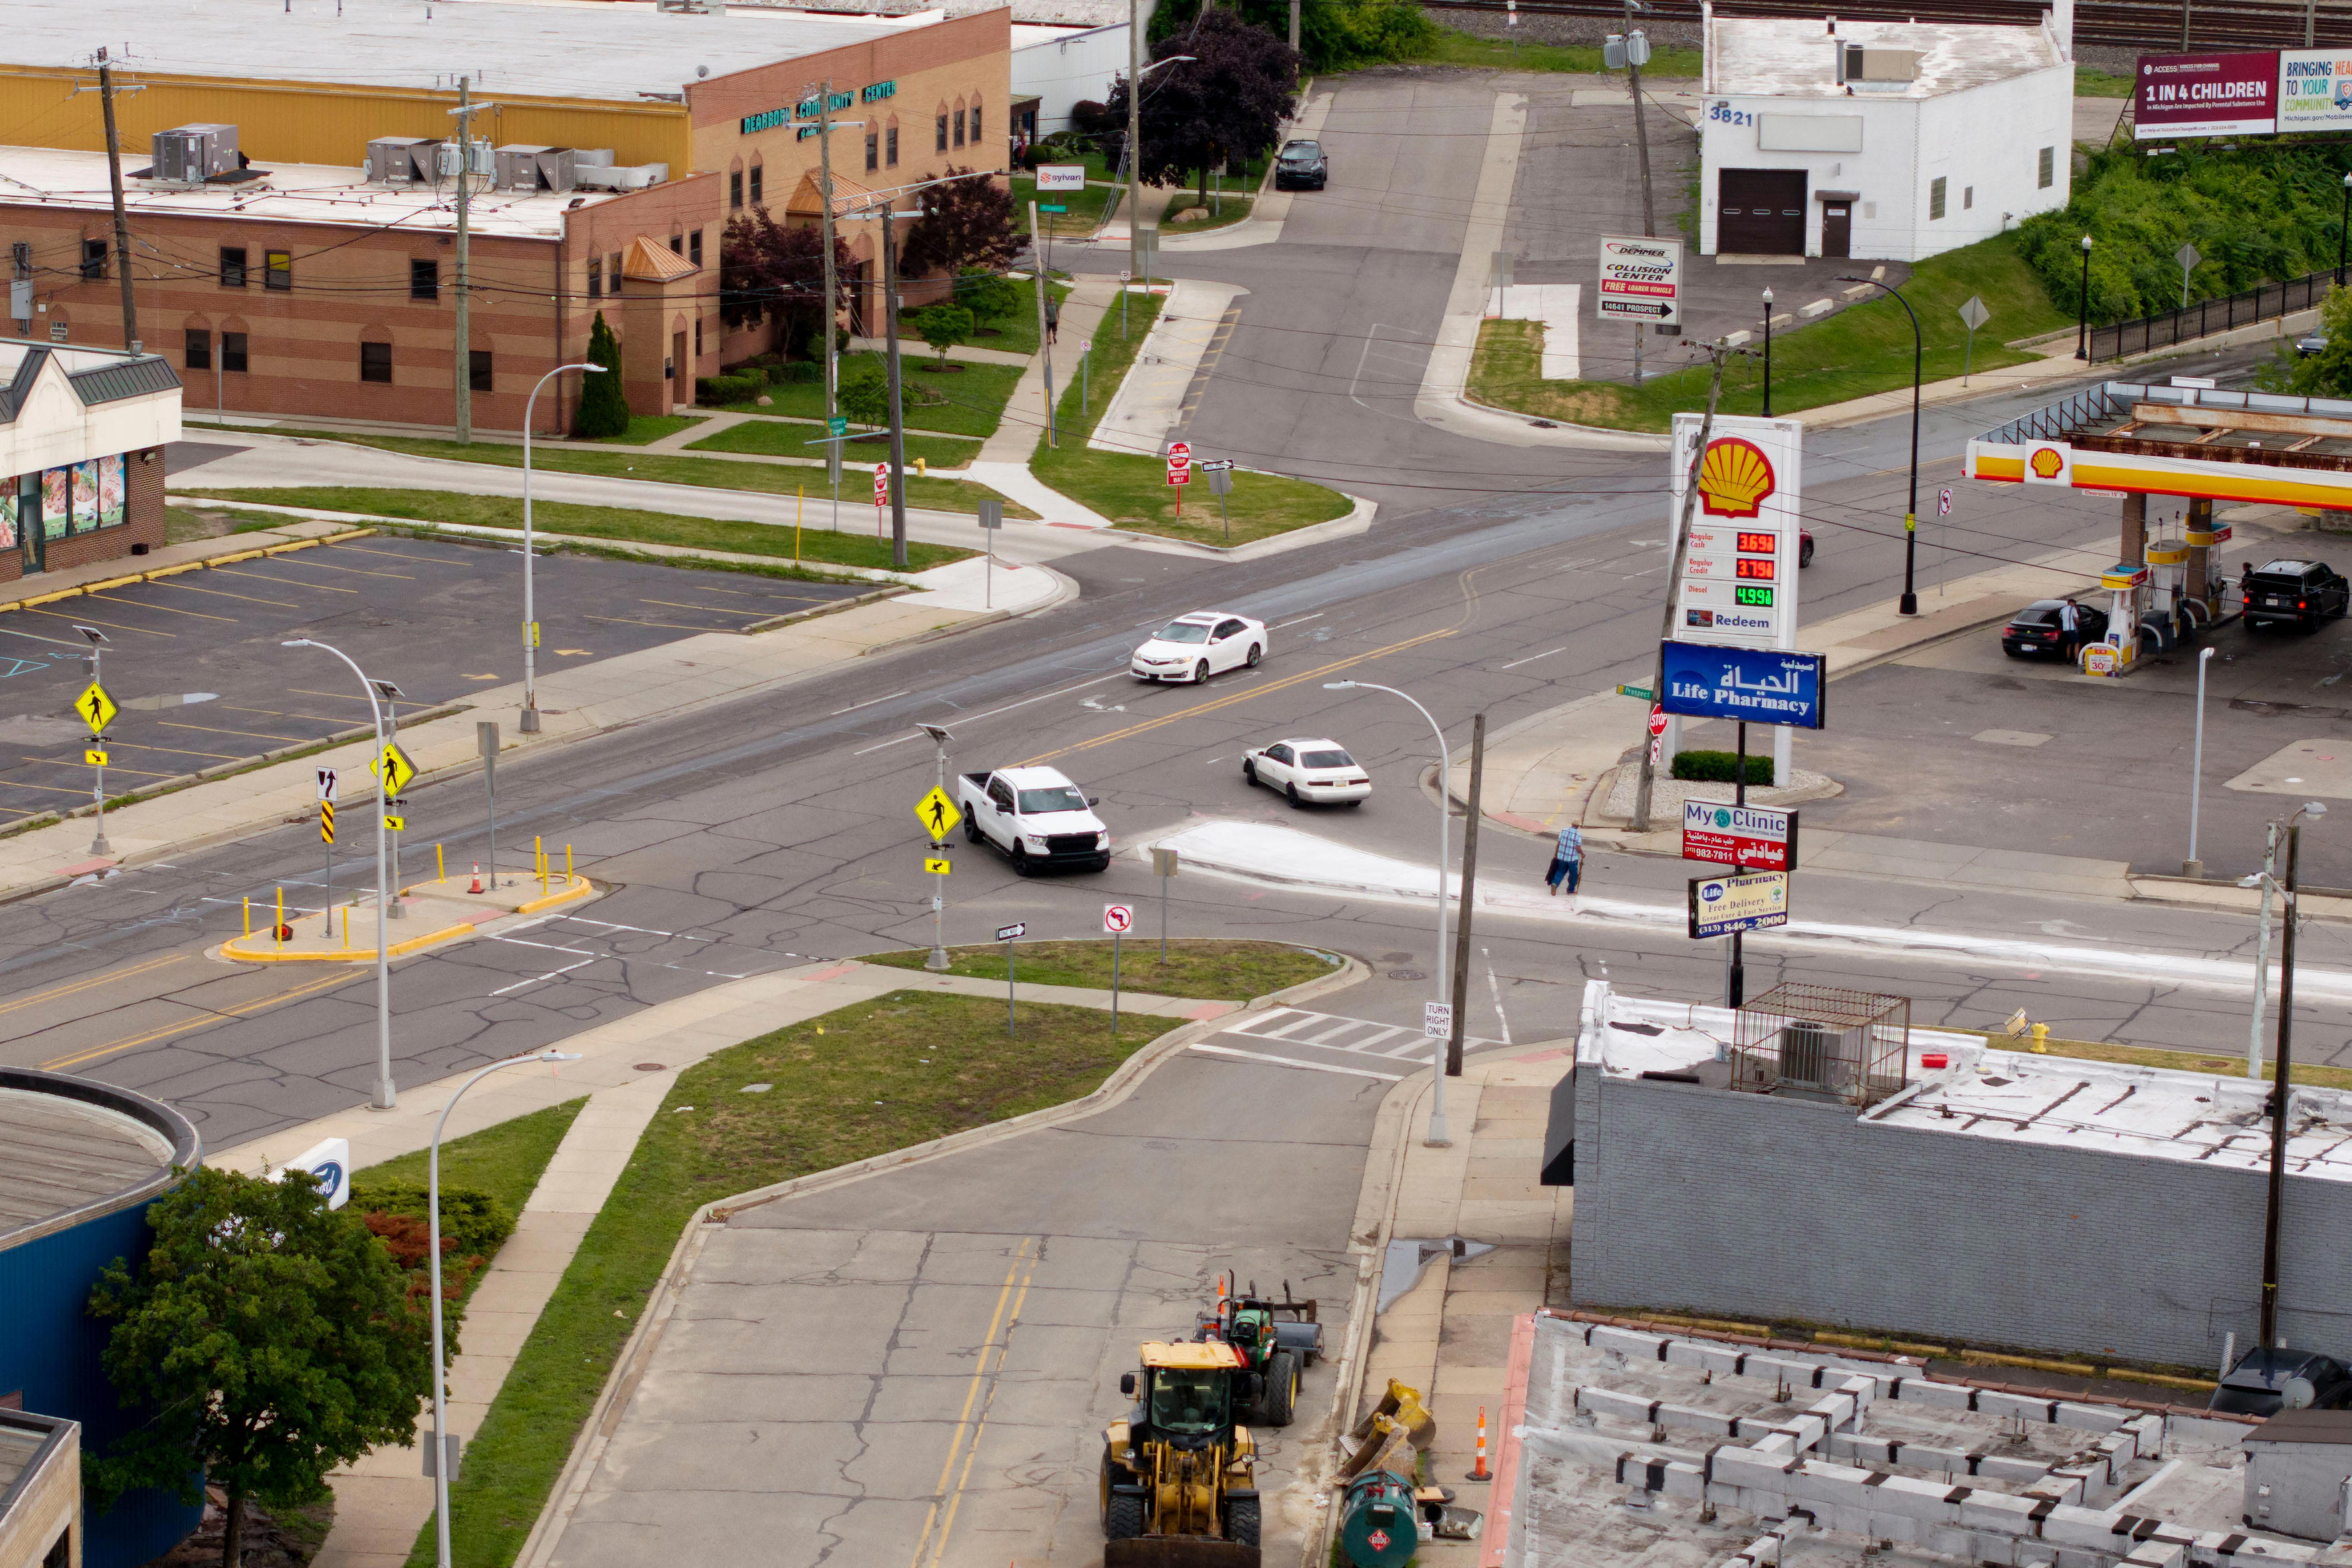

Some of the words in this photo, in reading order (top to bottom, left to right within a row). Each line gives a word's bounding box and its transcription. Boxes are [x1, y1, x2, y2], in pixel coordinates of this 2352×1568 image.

[2287, 61, 2332, 77] BRINGING
[2335, 60, 2352, 75] HEA
[2146, 85, 2156, 101] 1
[2159, 84, 2175, 101] IN
[2178, 84, 2188, 100] 4
[2191, 80, 2266, 100] CHILDREN
[2286, 80, 2297, 96] TO
[2302, 79, 2328, 95] YOUR
[742, 107, 791, 134] DEARBORN
[798, 91, 855, 119] COMUNITY
[864, 80, 897, 103] CENTER
[2285, 98, 2335, 112] COMMUNITY
[1710, 106, 1752, 127] 3821
[1619, 247, 1665, 257] DEMMER
[1606, 264, 1672, 274] COLLISION
[1615, 272, 1664, 281] CENTER
[1605, 281, 1626, 291] FREE
[1650, 286, 1673, 294] VEHICLE
[1626, 304, 1662, 314] PROSPECT
[1689, 532, 1714, 541] Regular
[1689, 557, 1713, 567] Regular
[1715, 614, 1770, 628] Redeem
[1780, 659, 1814, 672] صيدلية
[1720, 664, 1799, 696] الحياة
[1625, 686, 1650, 698] Prospect
[1672, 682, 1709, 700] Life
[1713, 689, 1810, 716] Pharmacy
[1651, 713, 1668, 727] STOP
[1687, 804, 1712, 825] My
[1733, 810, 1785, 831] Clinic
[1737, 842, 1784, 864] عيادتي
[1726, 873, 1783, 888] Pharmacy
[1703, 887, 1722, 898] Life
[1709, 904, 1726, 912] Free
[1730, 898, 1766, 909] Delivery
[1698, 924, 1721, 935] (313)
[1427, 1005, 1449, 1015] TURN
[1426, 1015, 1450, 1025] RIGHT
[1427, 1026, 1448, 1036] ONLY
